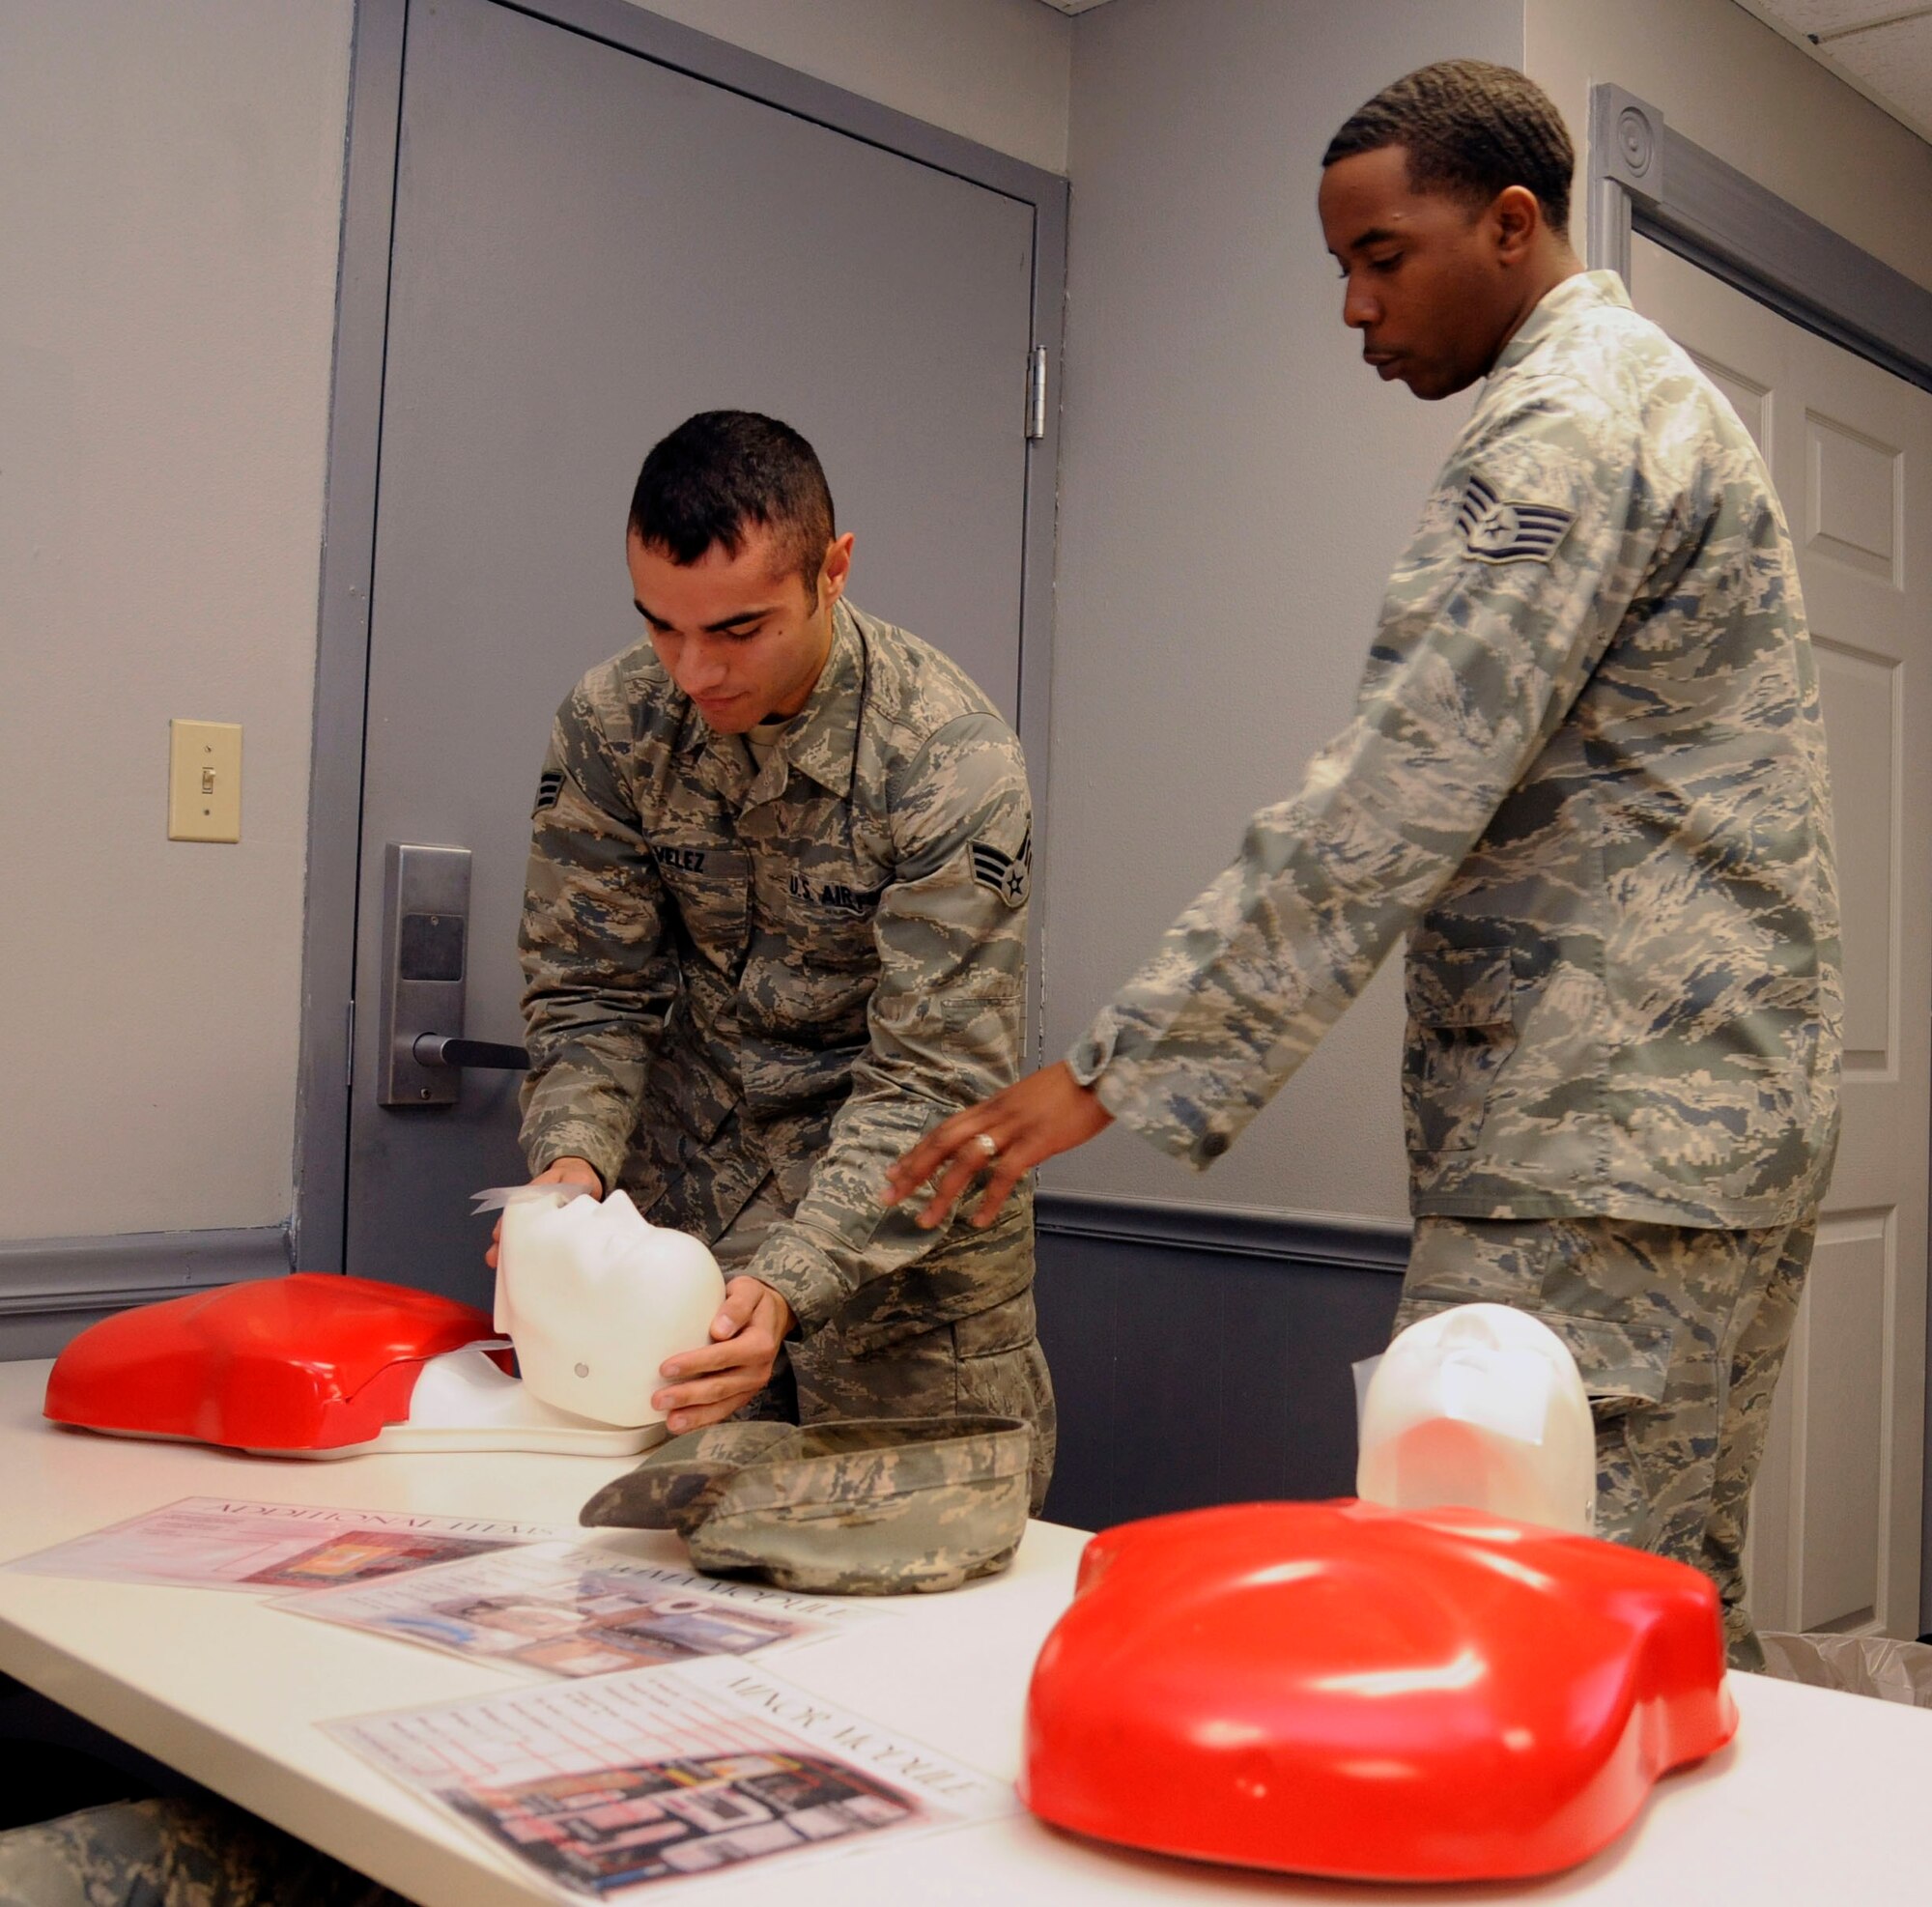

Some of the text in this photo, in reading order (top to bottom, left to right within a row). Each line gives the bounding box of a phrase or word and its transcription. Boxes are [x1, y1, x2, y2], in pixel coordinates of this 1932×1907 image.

[656, 845, 705, 873] VELEZ
[790, 874, 814, 902] U.S.
[822, 885, 853, 907] AIR
[212, 1502, 433, 1528] ADDITIONAL
